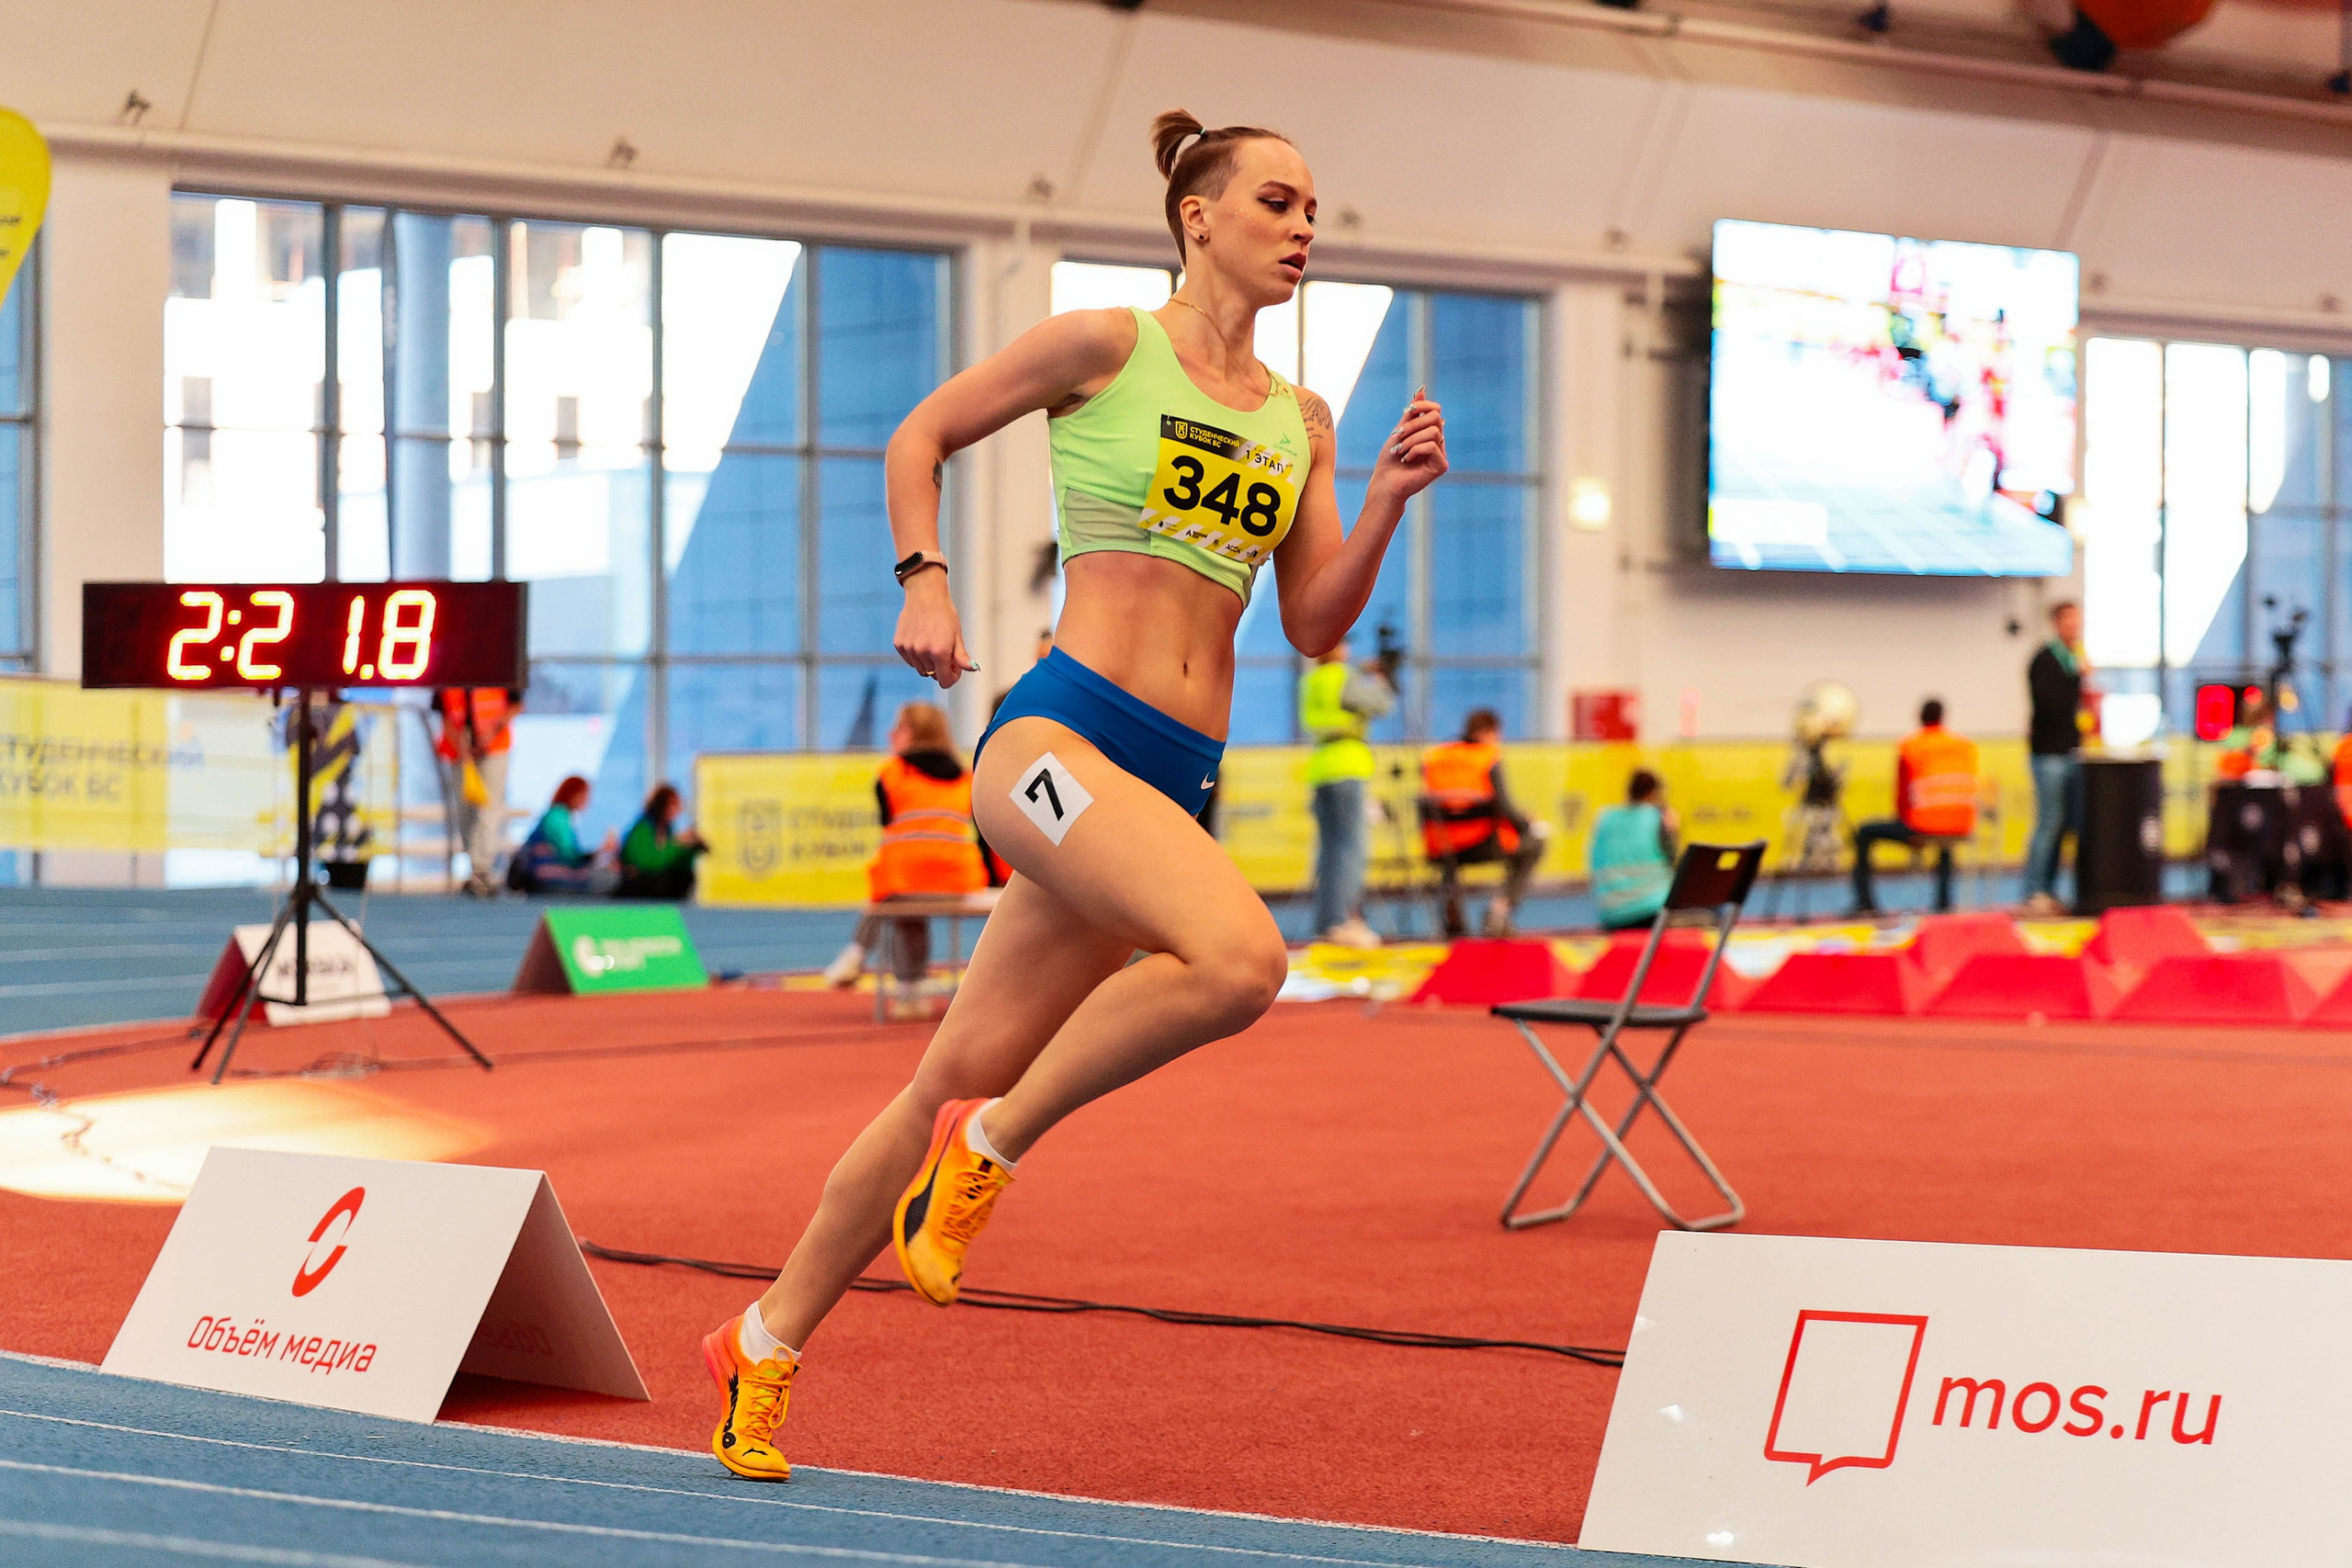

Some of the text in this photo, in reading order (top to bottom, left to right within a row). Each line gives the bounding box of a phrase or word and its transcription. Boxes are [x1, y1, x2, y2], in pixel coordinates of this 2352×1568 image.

[1190, 426, 1240, 448] СТУДЕНЧЕСКИЙ
[1190, 433, 1212, 446] КУБОК
[1246, 449, 1250, 460] 1
[1254, 453, 1284, 474] ЭТАП
[1163, 455, 1281, 537] 348
[1023, 767, 1065, 822] 7
[187, 1315, 378, 1376] Объём медиа
[1931, 1376, 2223, 1446] mos.ru
